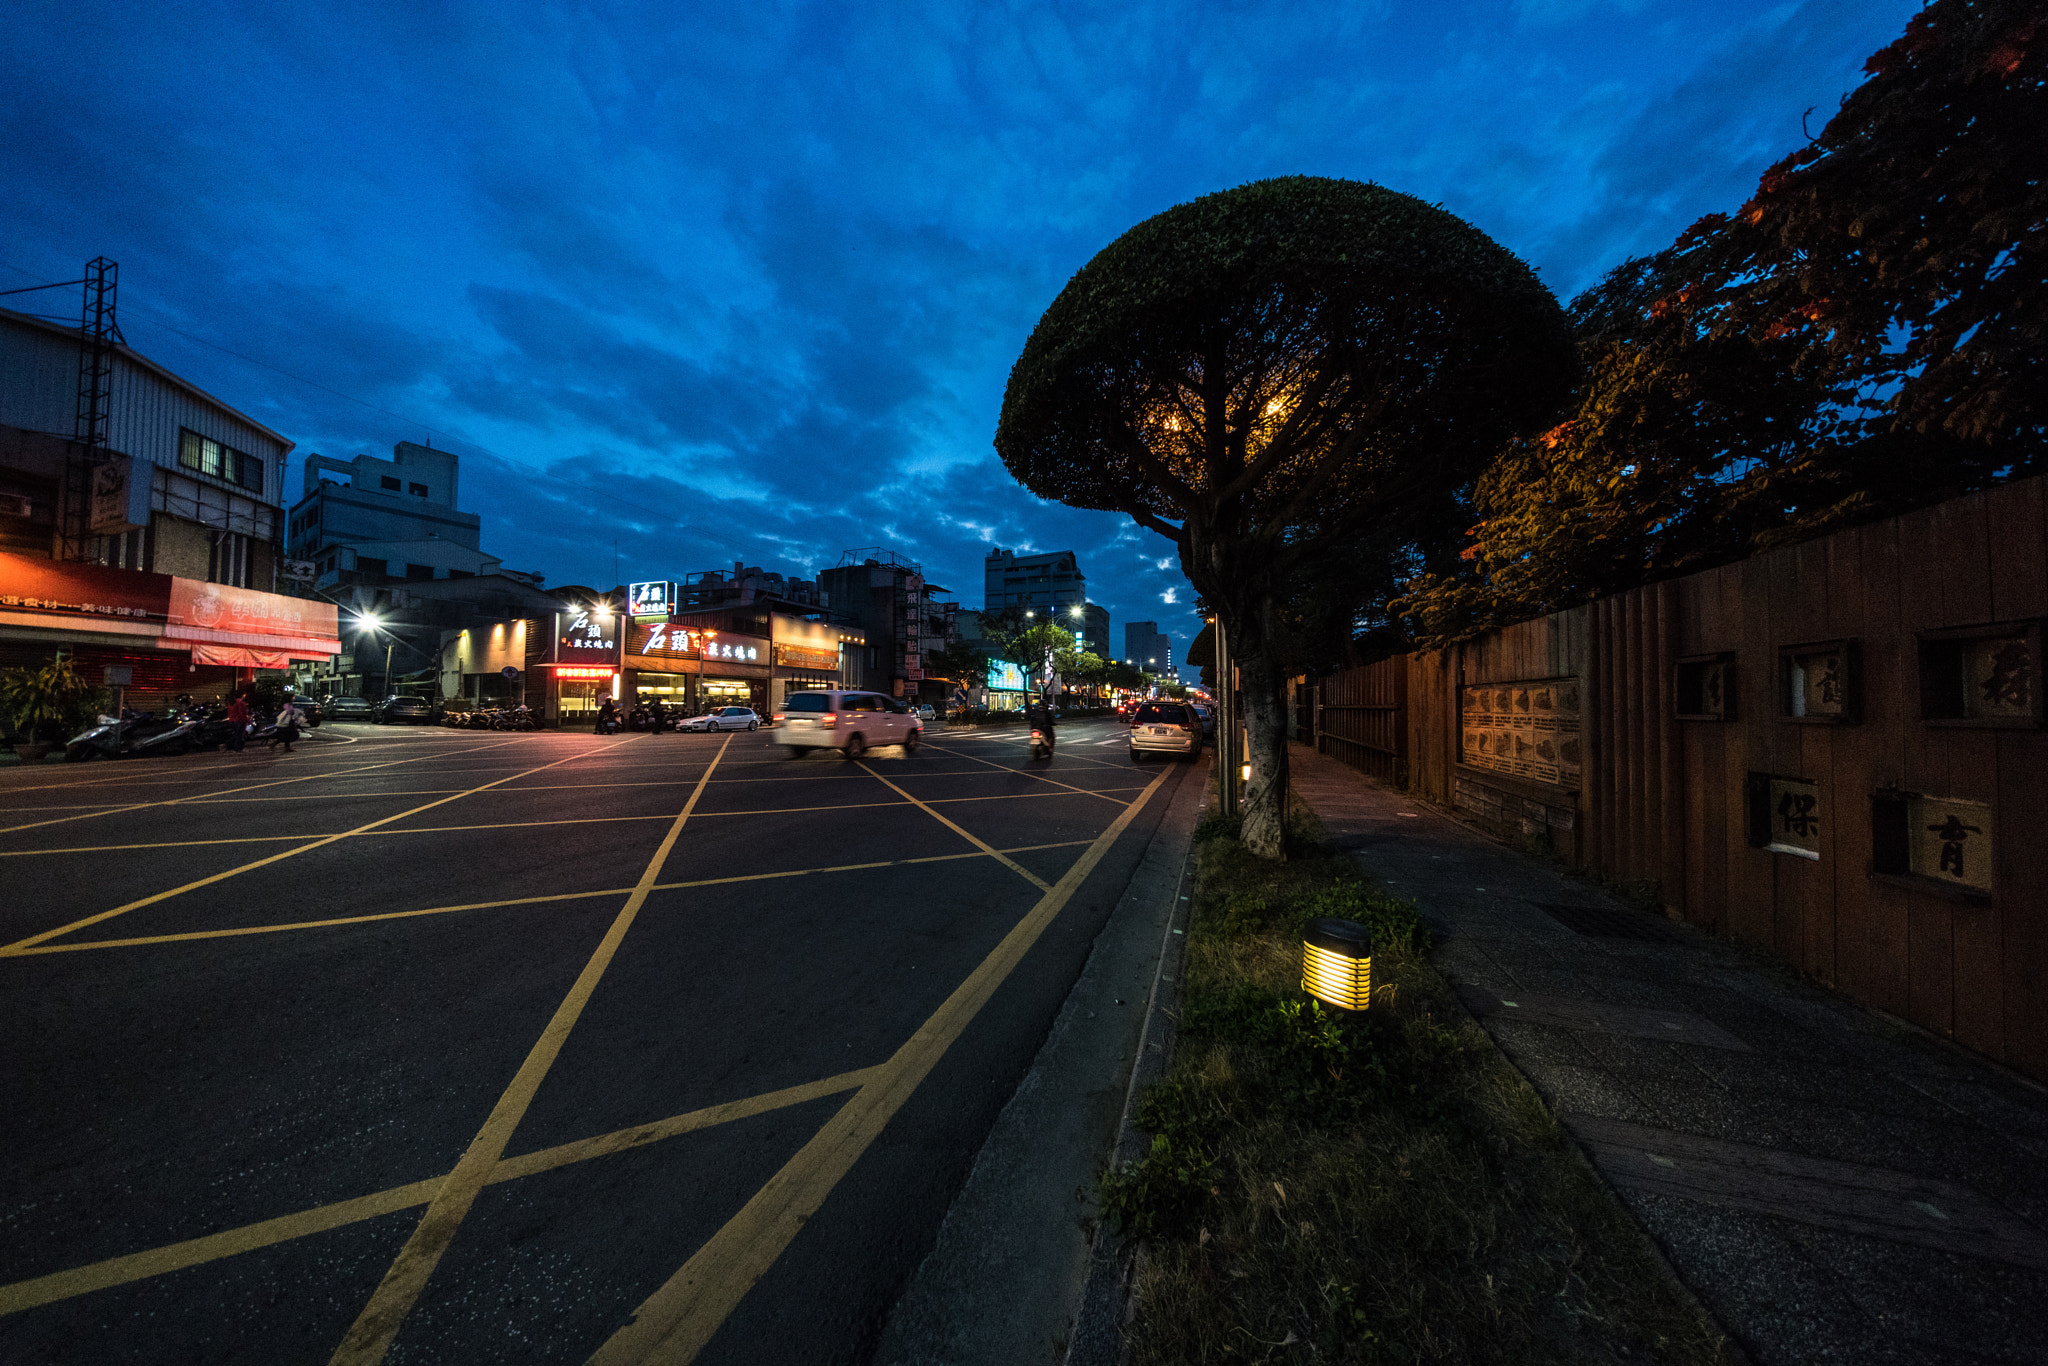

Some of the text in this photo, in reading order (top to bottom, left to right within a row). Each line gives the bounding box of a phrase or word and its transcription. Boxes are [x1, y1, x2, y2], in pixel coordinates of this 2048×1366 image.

[636, 583, 661, 604] 石頭
[568, 611, 602, 638] 石頭
[641, 623, 689, 654] 石頭
[1777, 790, 1984, 878] 保 育
